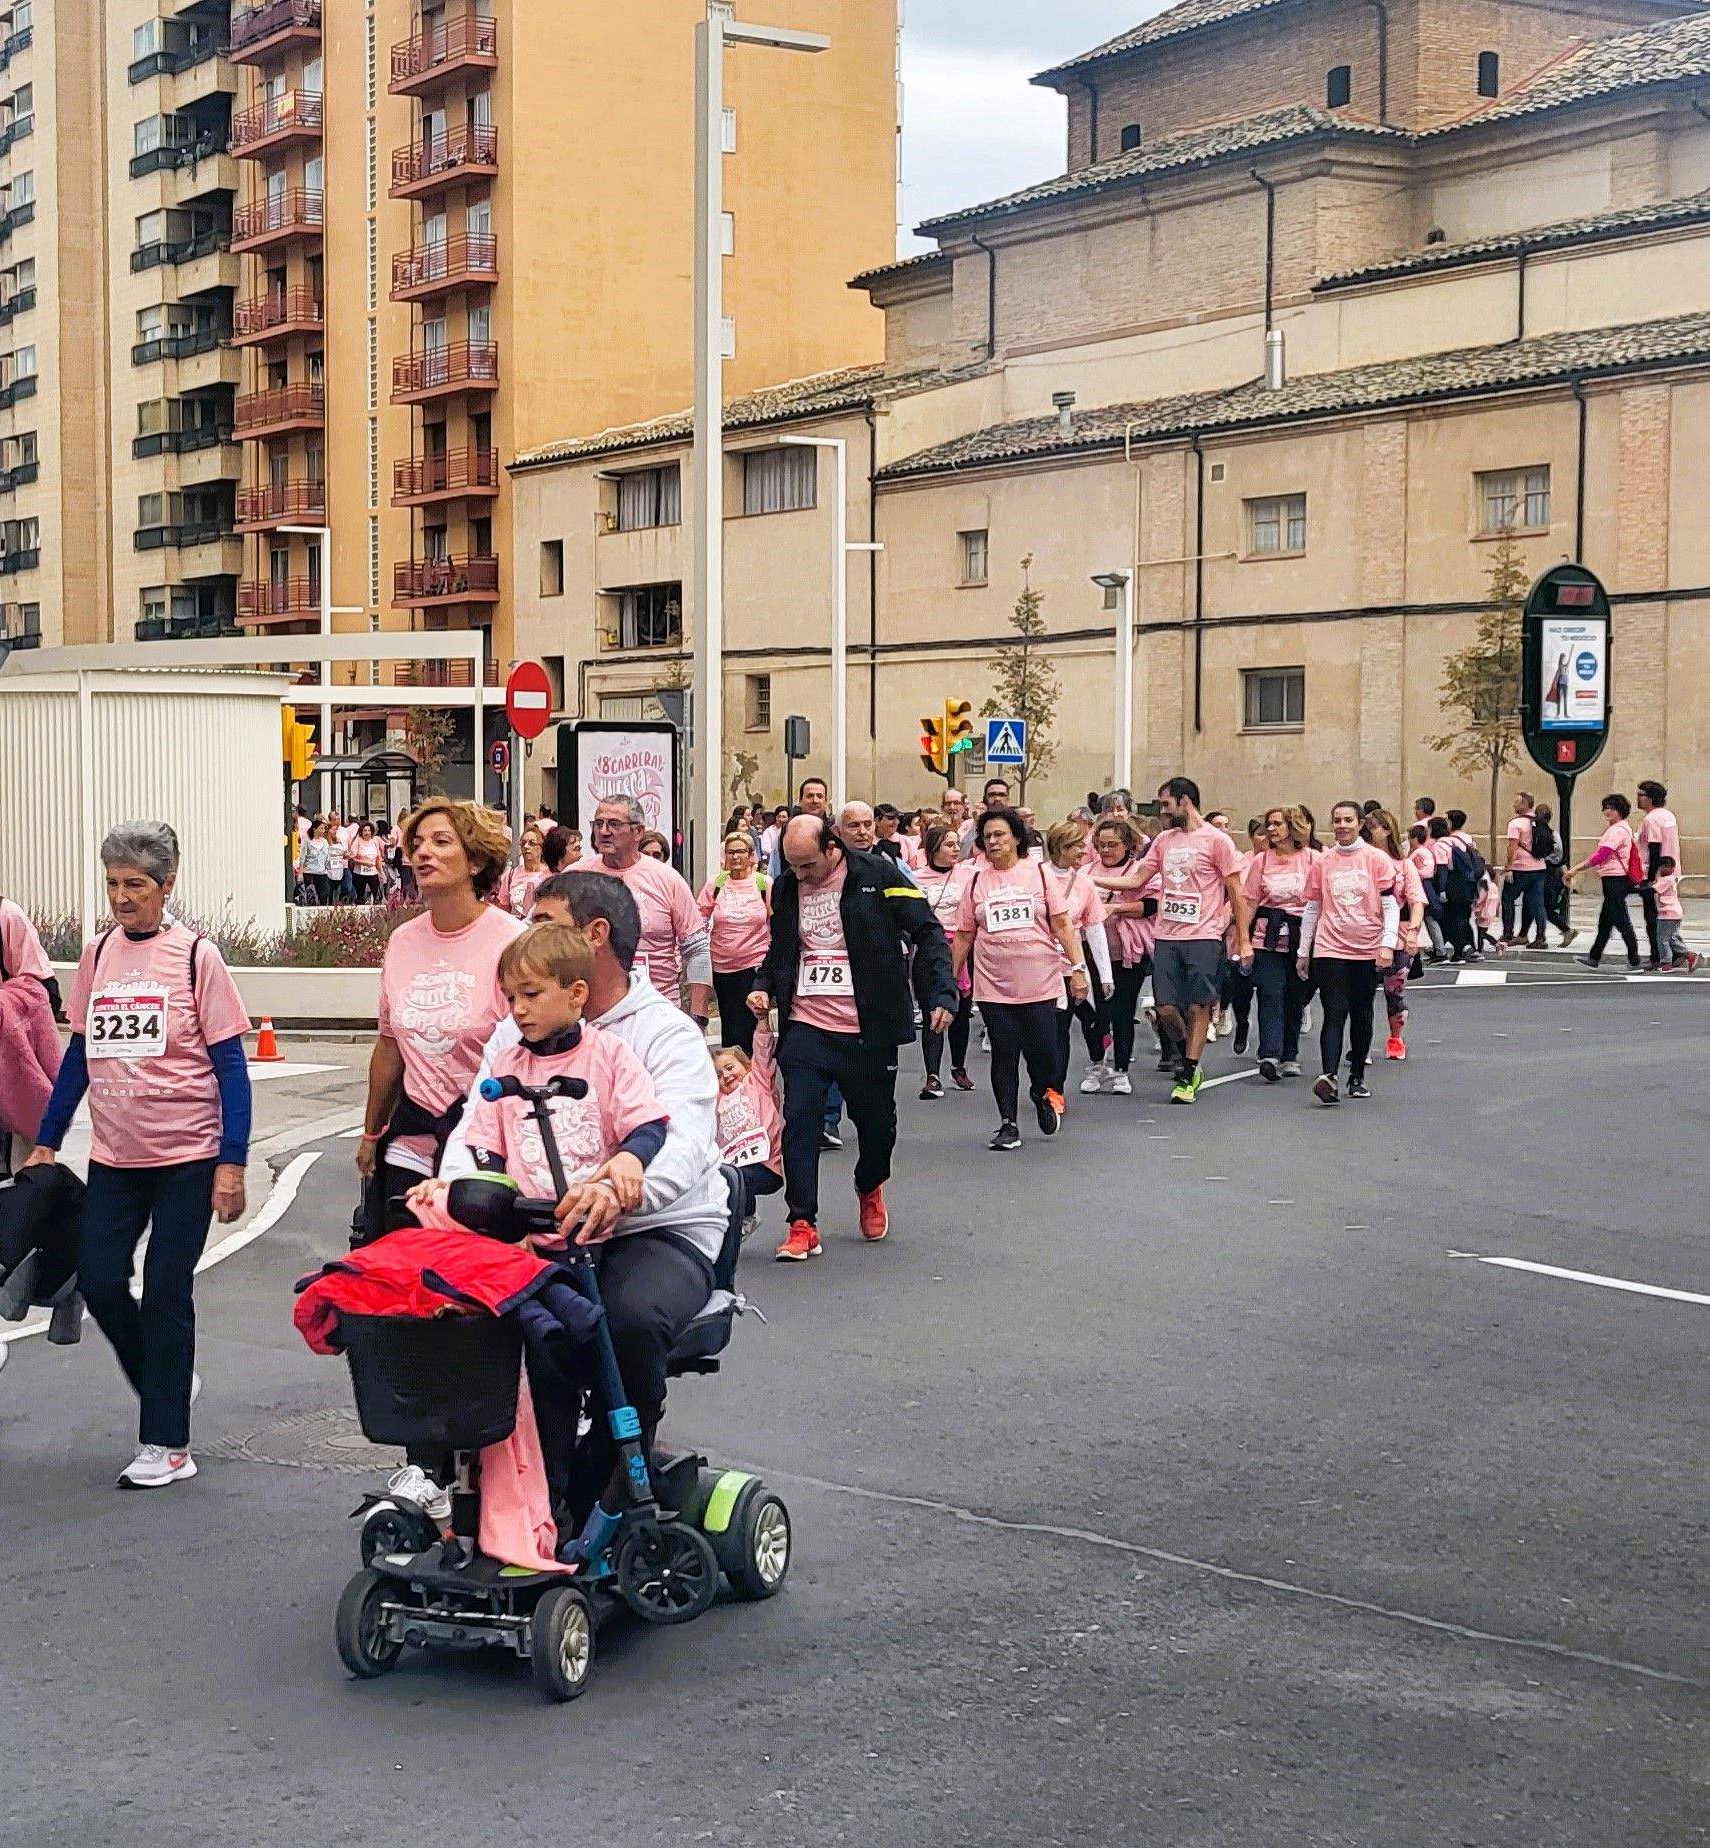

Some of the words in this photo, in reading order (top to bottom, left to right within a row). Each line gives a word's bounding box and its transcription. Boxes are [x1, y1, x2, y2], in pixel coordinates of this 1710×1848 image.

[992, 907, 1030, 922] 1381
[1164, 901, 1197, 915] 2053
[809, 966, 843, 984] 478
[92, 1014, 160, 1041] 3234
